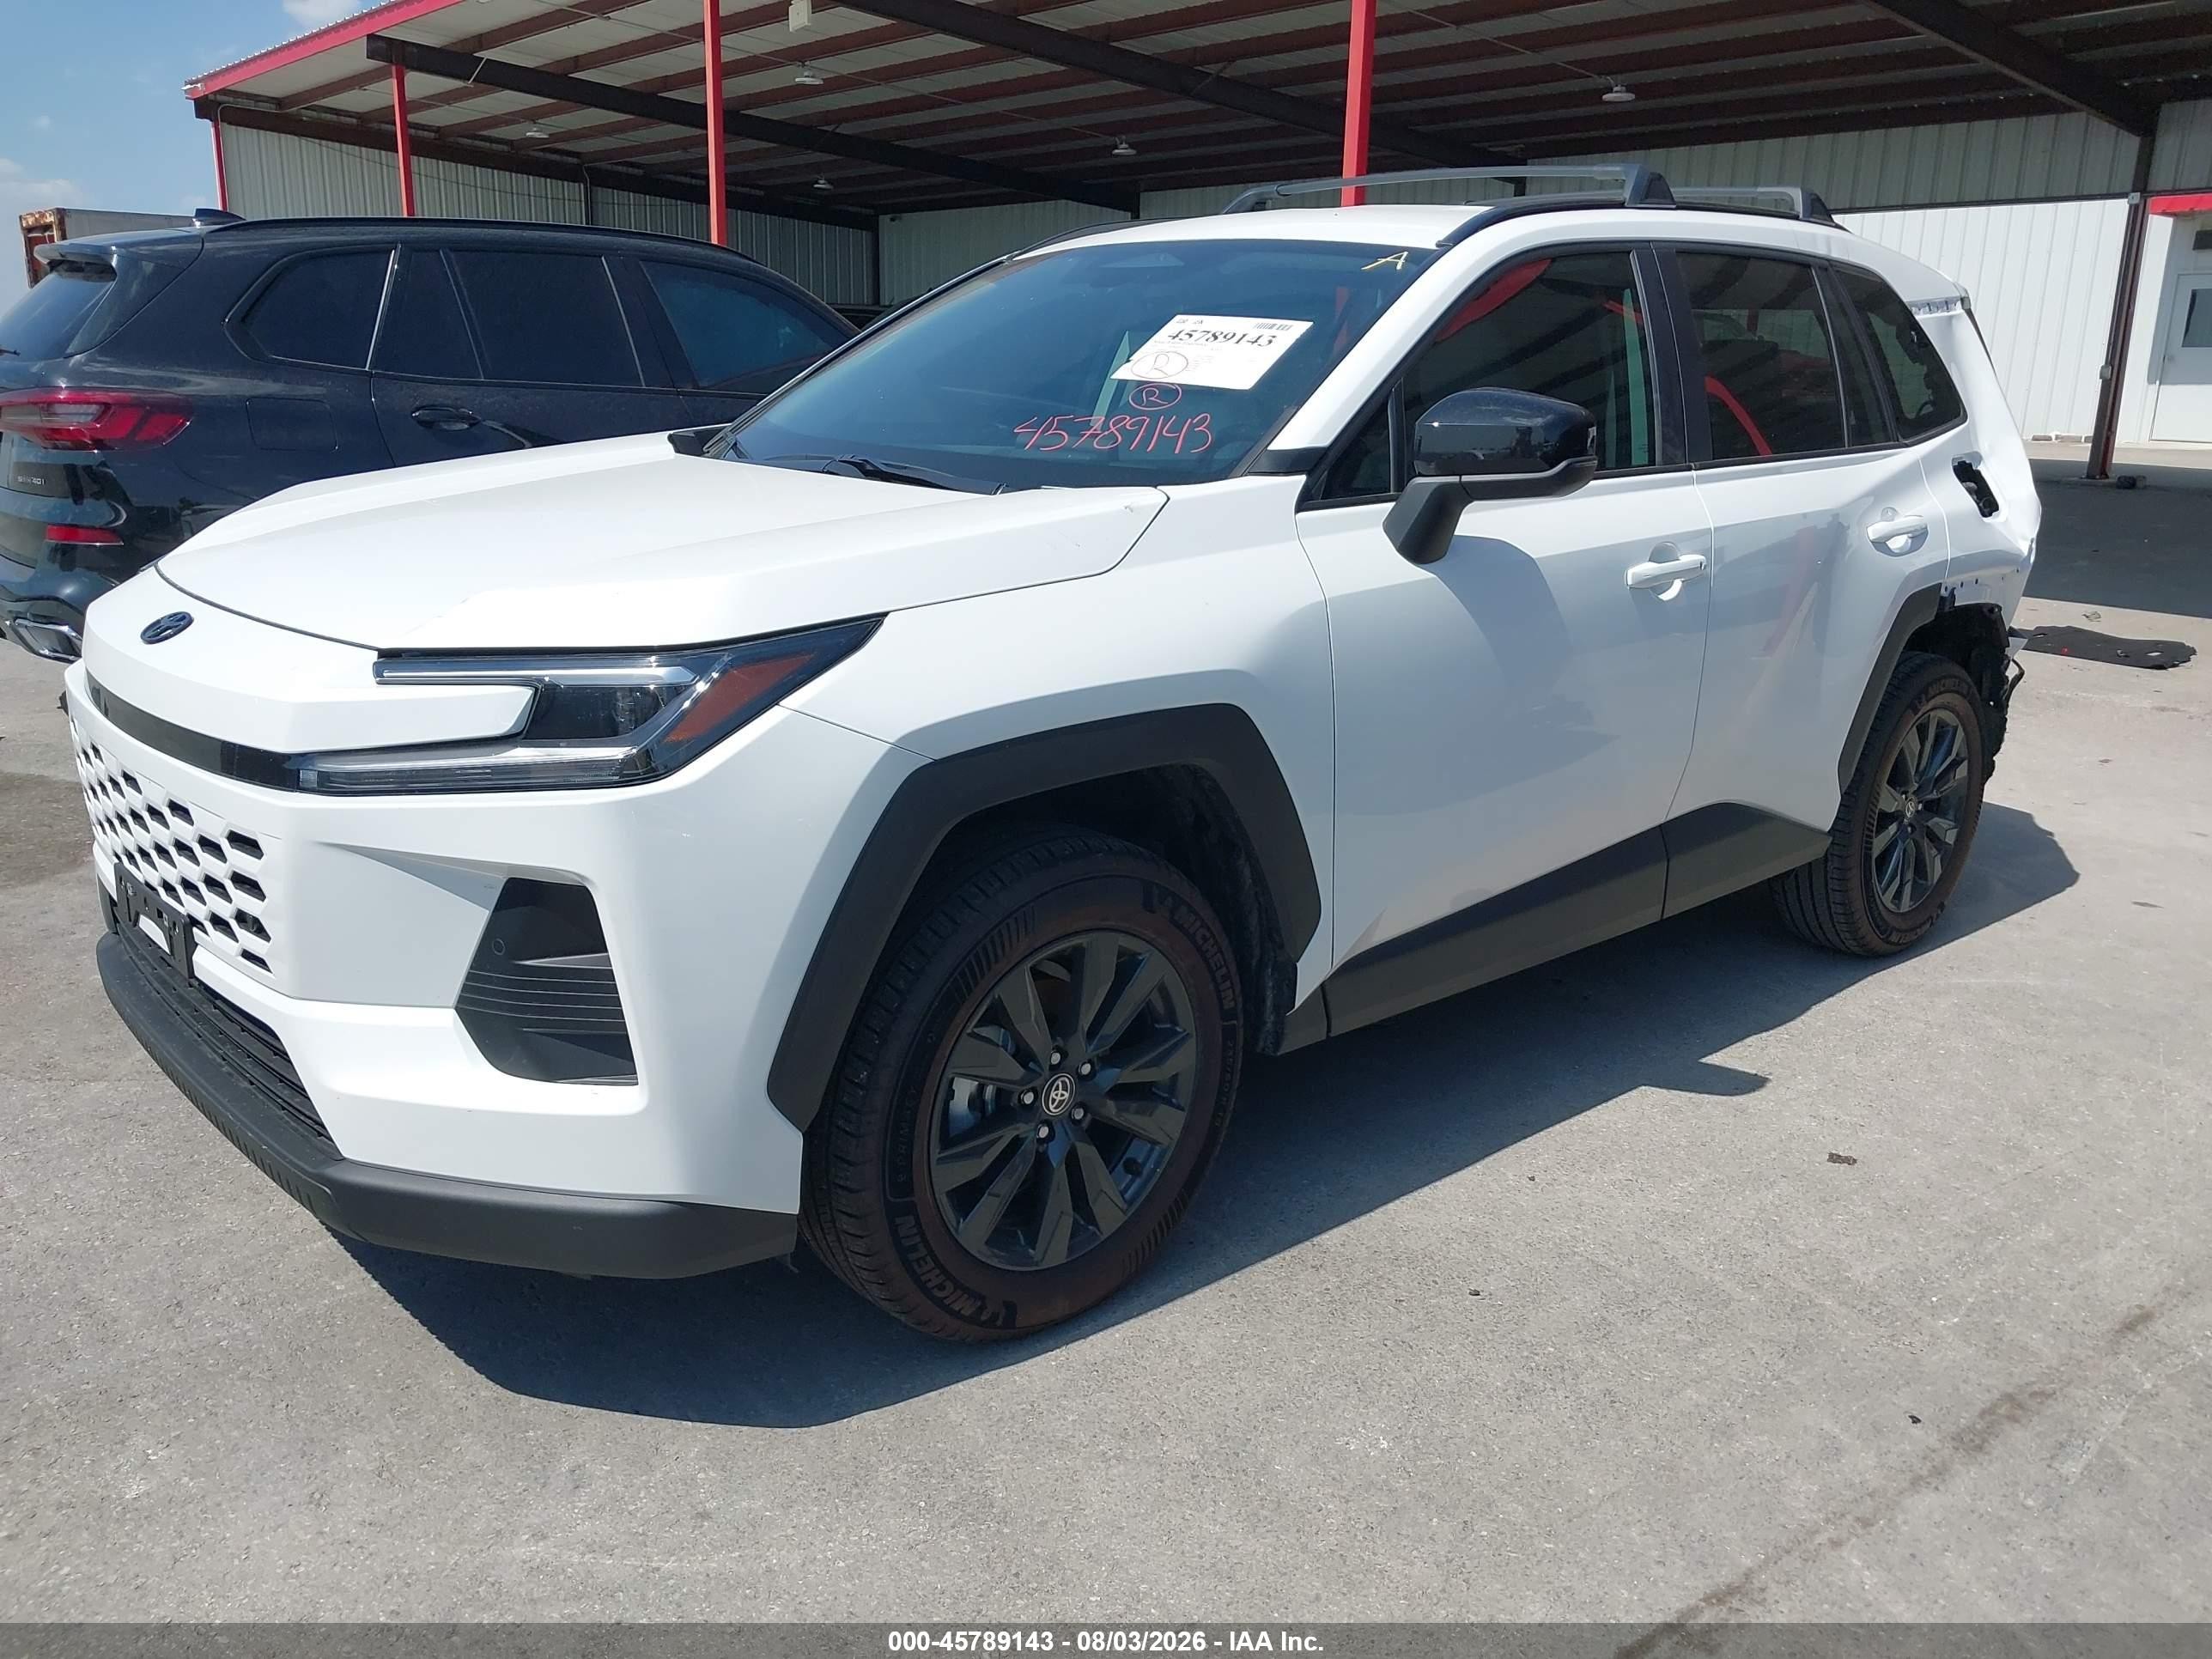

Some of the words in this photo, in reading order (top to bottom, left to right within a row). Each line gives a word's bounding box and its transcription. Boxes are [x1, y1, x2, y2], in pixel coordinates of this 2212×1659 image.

[1361, 252, 1409, 271] A
[1167, 328, 1278, 348] 45789143
[1012, 412, 1213, 455] 45789143
[1173, 905, 1236, 1011] MICHELIN
[894, 1215, 983, 1316] MICHELIN
